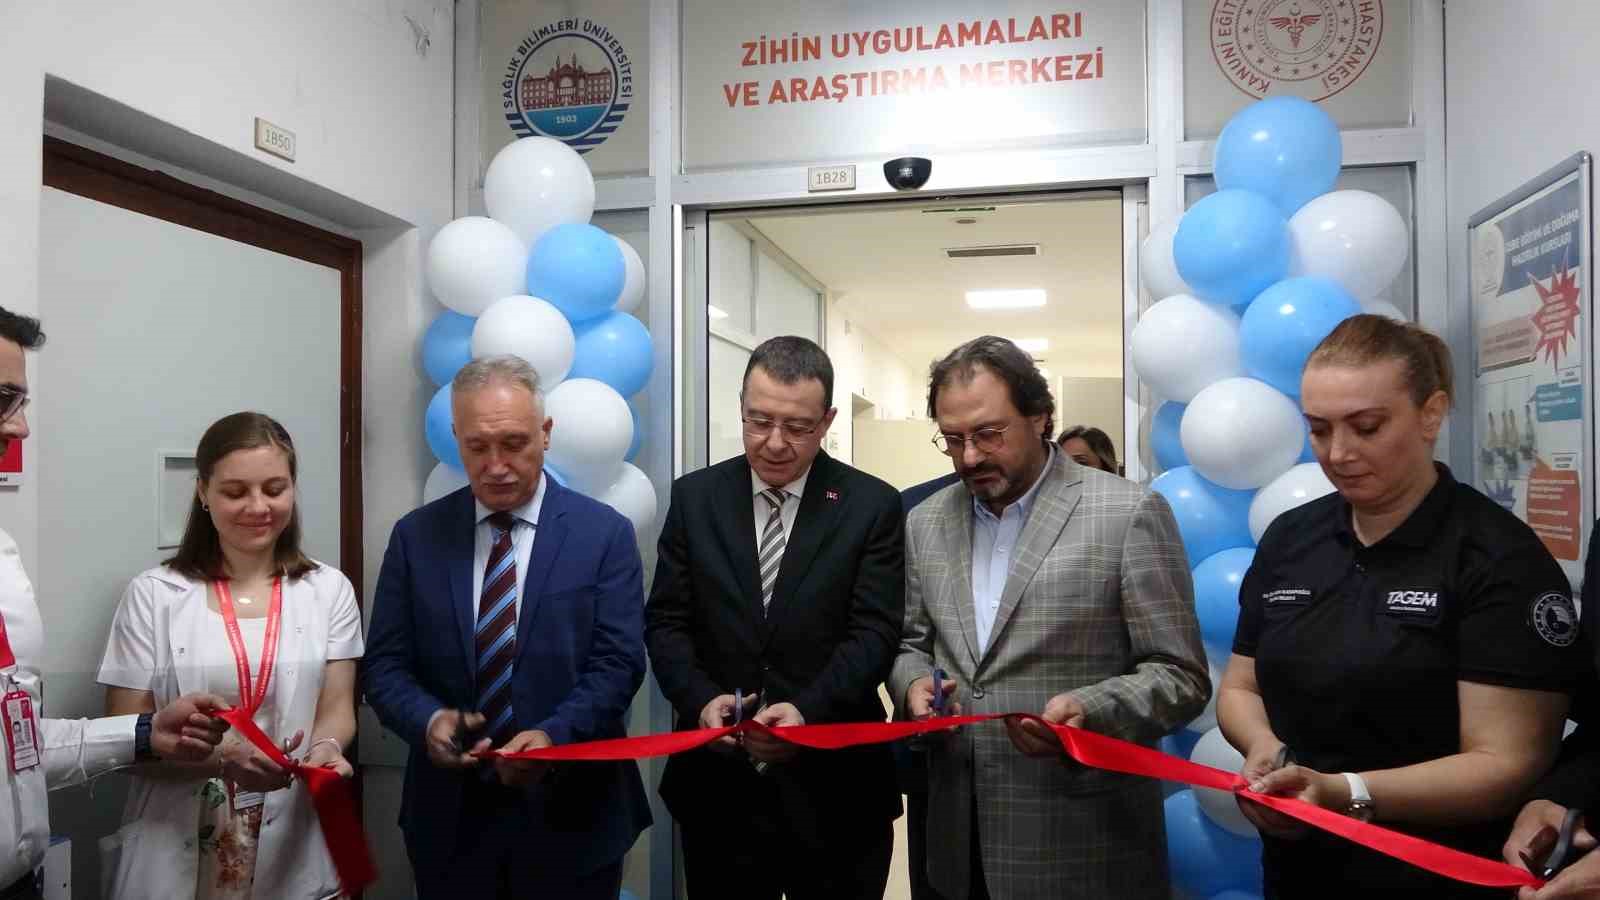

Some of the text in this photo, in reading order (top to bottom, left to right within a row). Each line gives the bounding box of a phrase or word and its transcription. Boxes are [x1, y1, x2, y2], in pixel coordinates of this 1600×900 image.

[741, 12, 1082, 67] ZİHİN UYGULAMALARI
[502, 57, 521, 109] SAĞLIK
[723, 46, 1104, 108] VE ARAŞTIRMA MERKEZİ
[816, 170, 848, 185] 1B28
[1386, 591, 1438, 607] TAGEM
